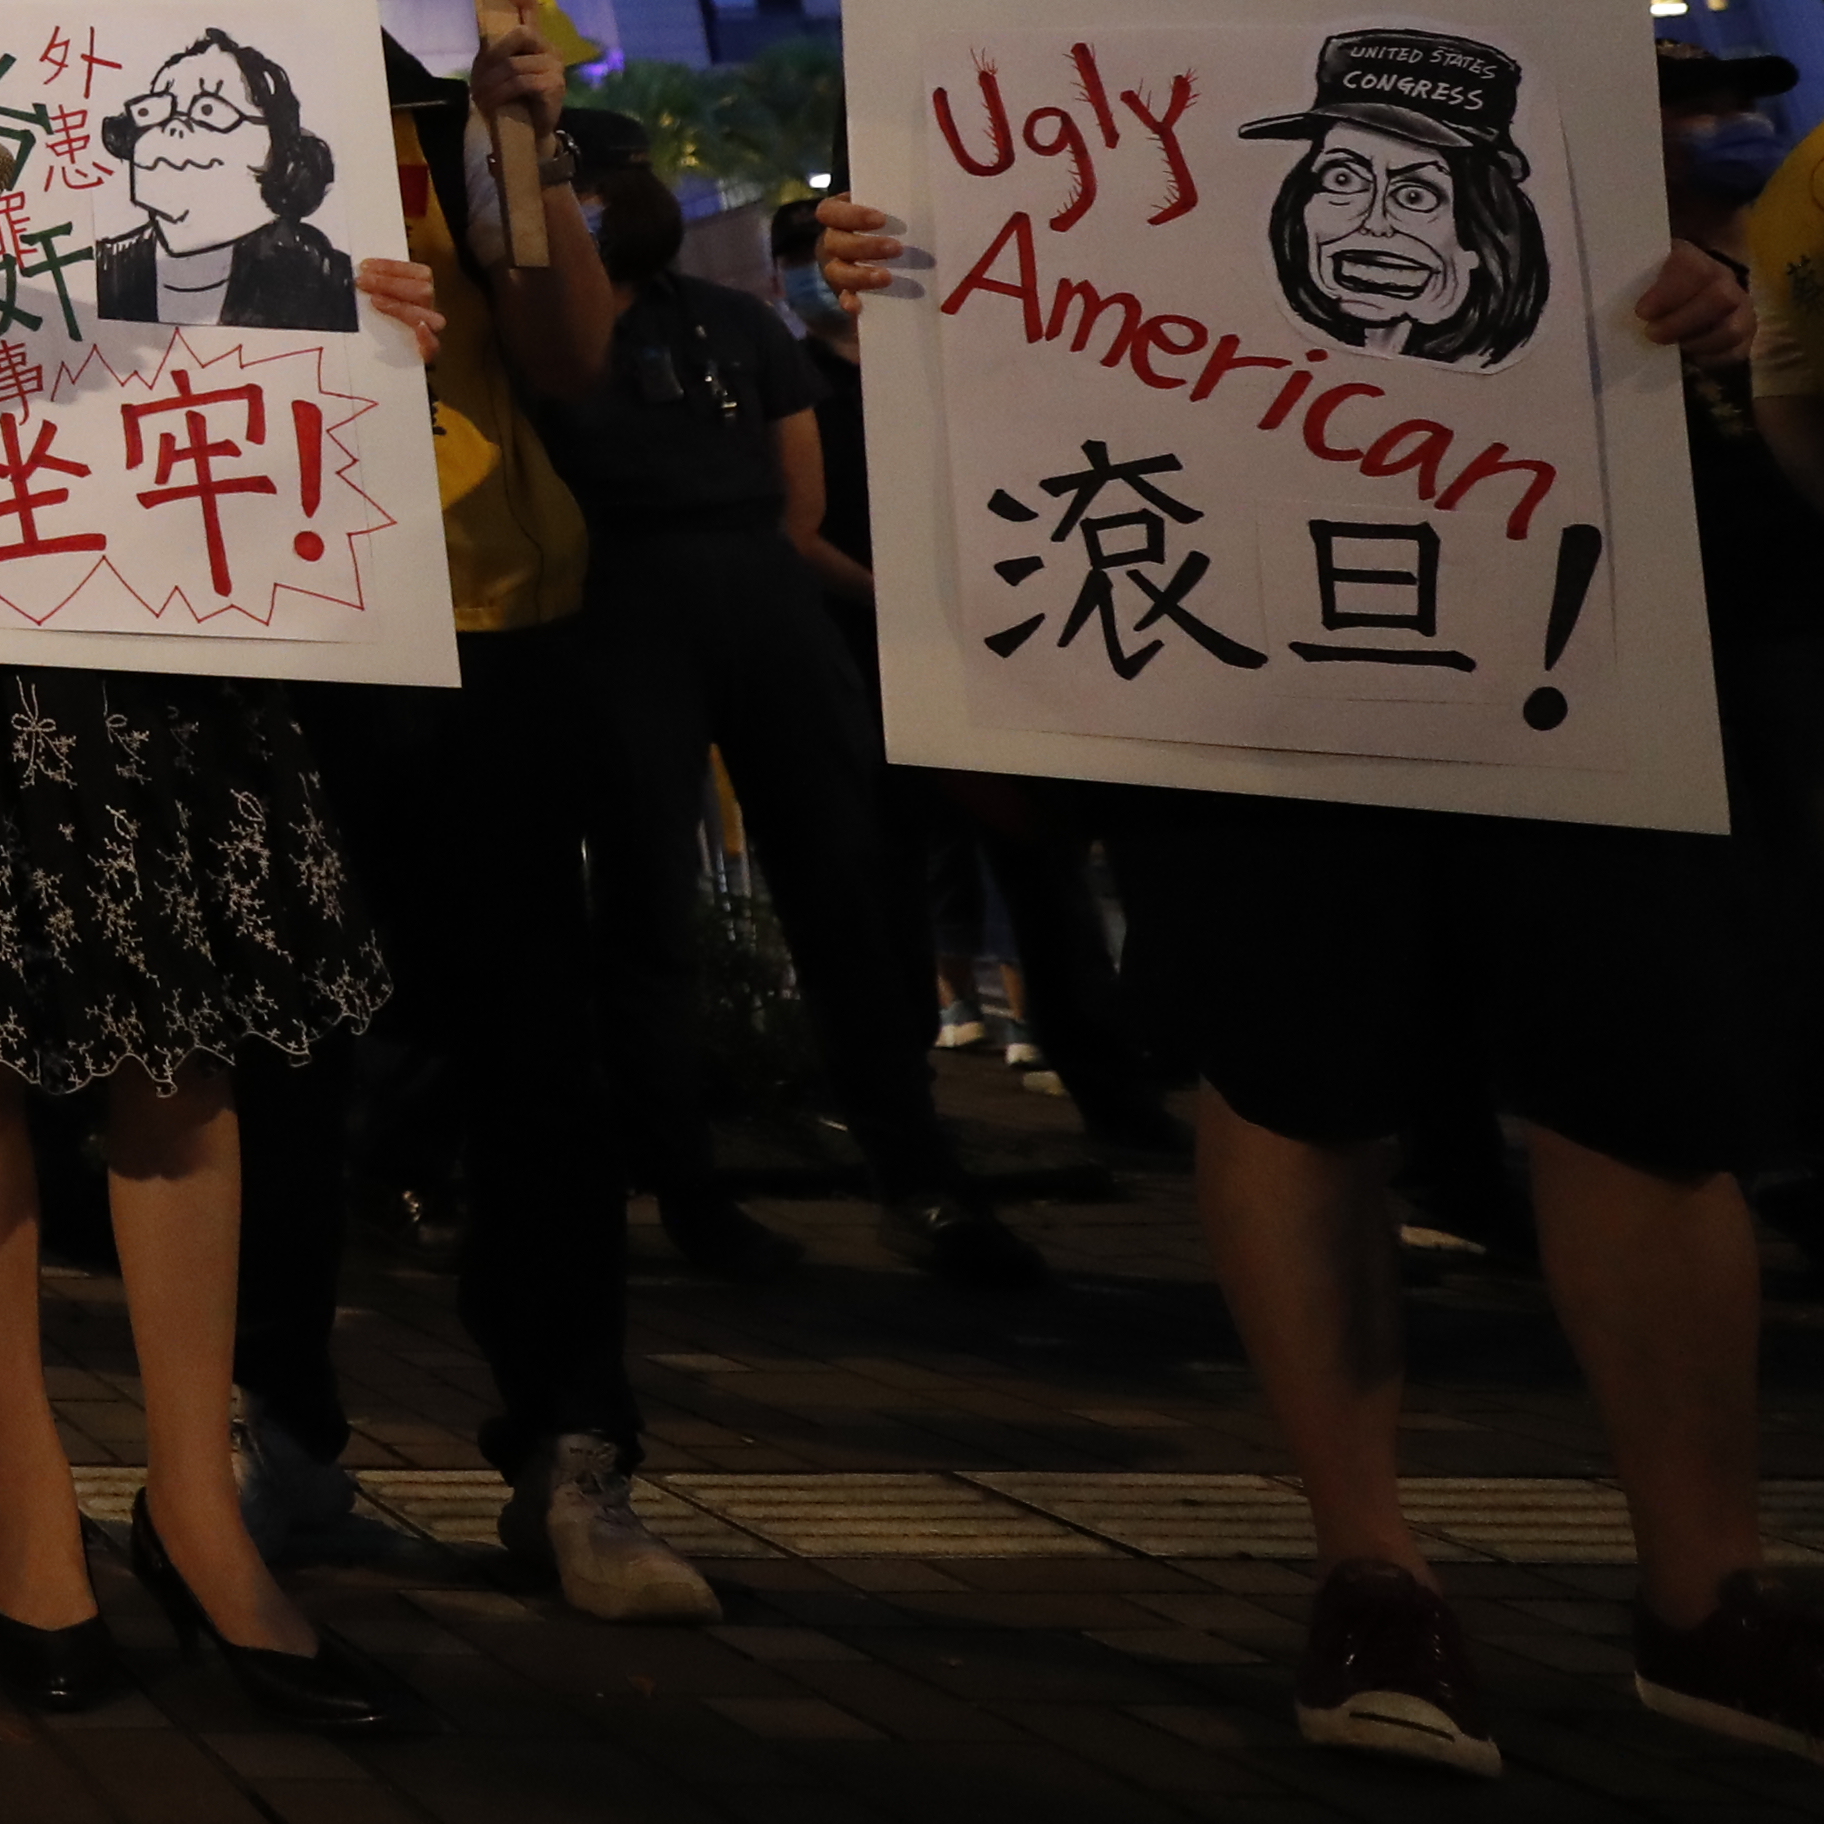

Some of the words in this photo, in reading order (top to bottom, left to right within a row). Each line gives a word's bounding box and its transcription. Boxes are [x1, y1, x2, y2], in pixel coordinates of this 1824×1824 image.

[1343, 71, 1484, 110] CONGRESS
[1350, 46, 1424, 63] UNITED
[1429, 49, 1497, 79] STATES
[932, 42, 1201, 232] Ugly
[941, 211, 1558, 540] American
